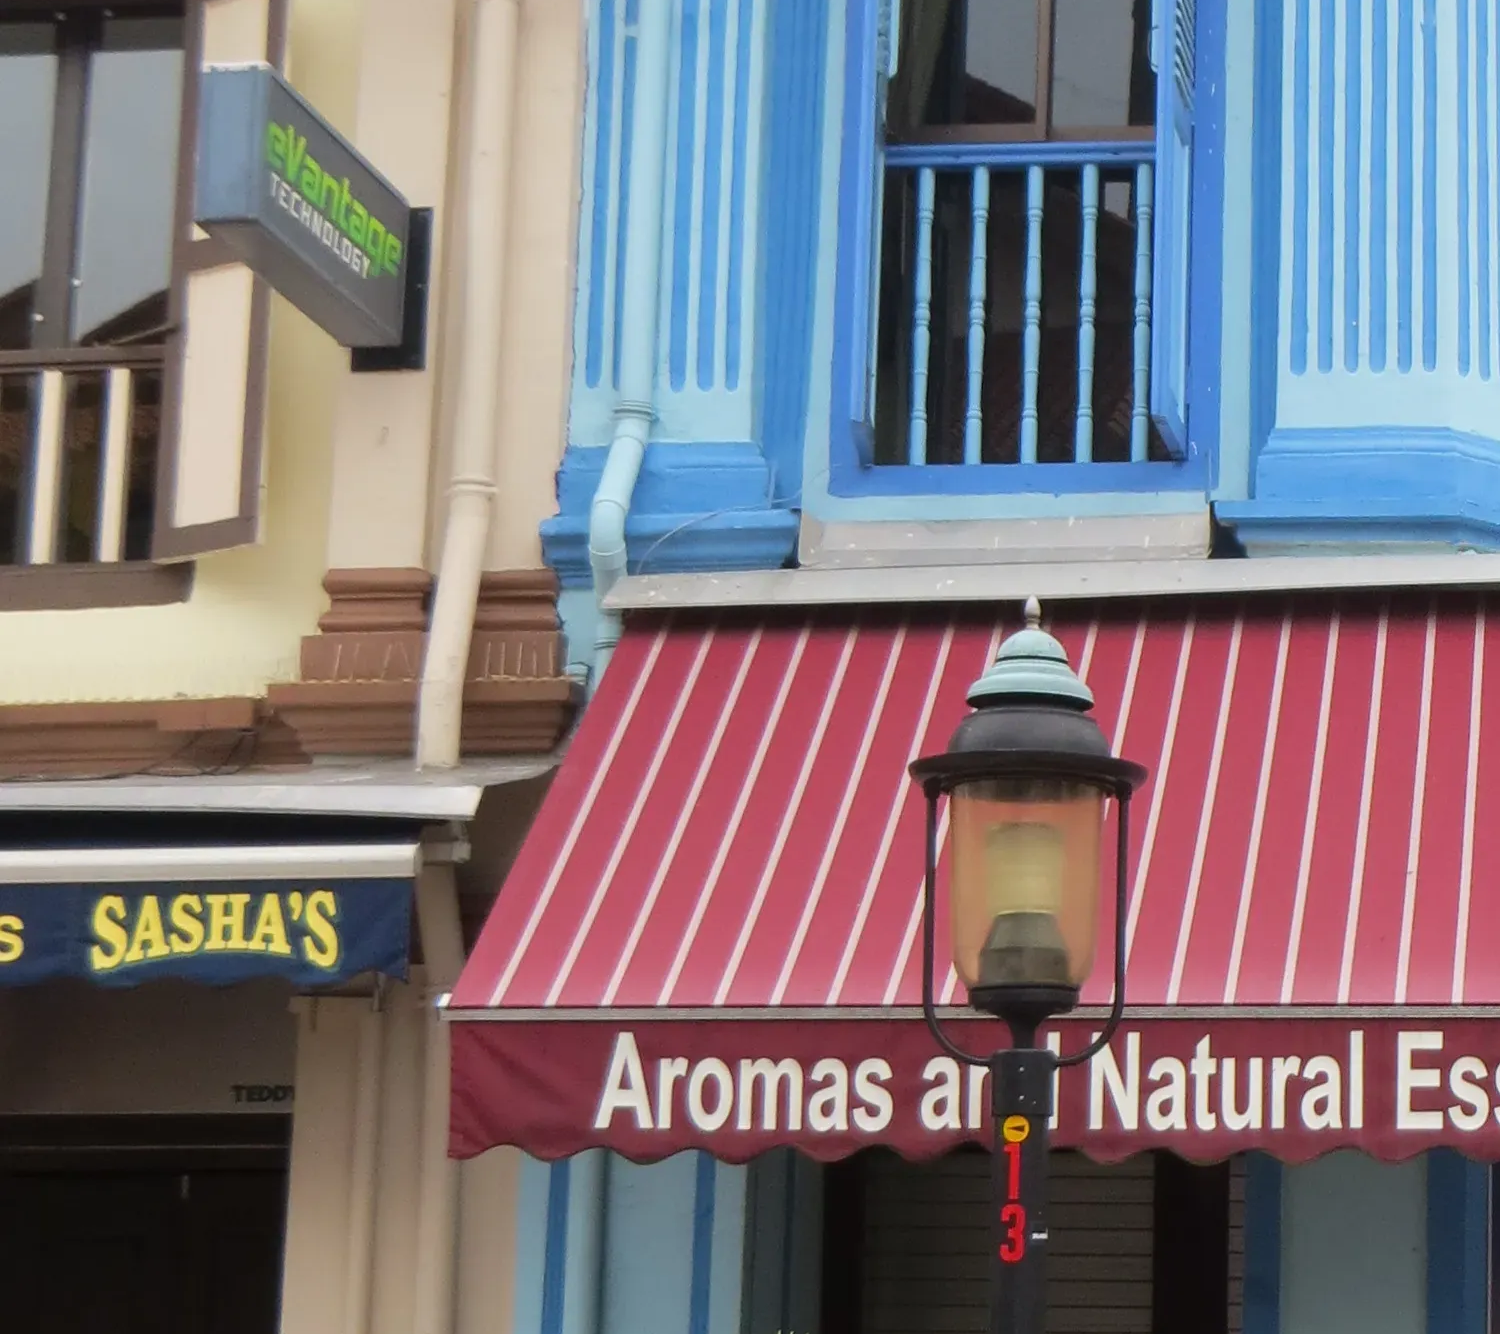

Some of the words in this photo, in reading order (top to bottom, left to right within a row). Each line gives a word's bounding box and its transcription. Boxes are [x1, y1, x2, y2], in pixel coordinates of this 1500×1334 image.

[271, 171, 370, 280] TECHNOLOGY
[91, 890, 339, 971] SASHA'S
[594, 1031, 894, 1133] Aromas
[1088, 1030, 1363, 1133] Natural
